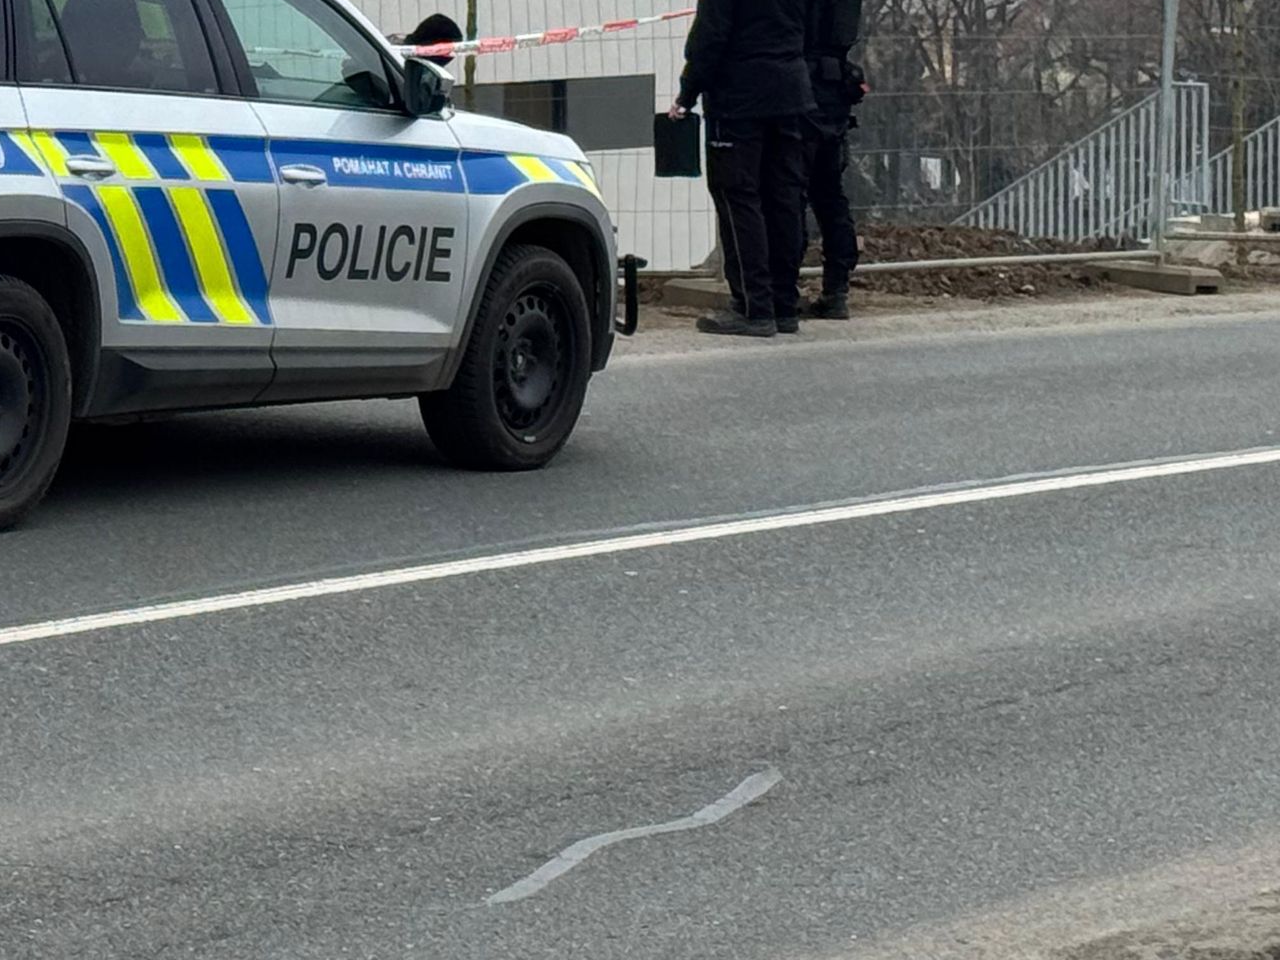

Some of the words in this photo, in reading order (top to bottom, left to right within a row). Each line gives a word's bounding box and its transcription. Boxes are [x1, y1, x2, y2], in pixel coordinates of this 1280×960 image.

[332, 155, 390, 177] POMÁHAT
[393, 162, 403, 177] A
[285, 222, 456, 283] POLICIE
